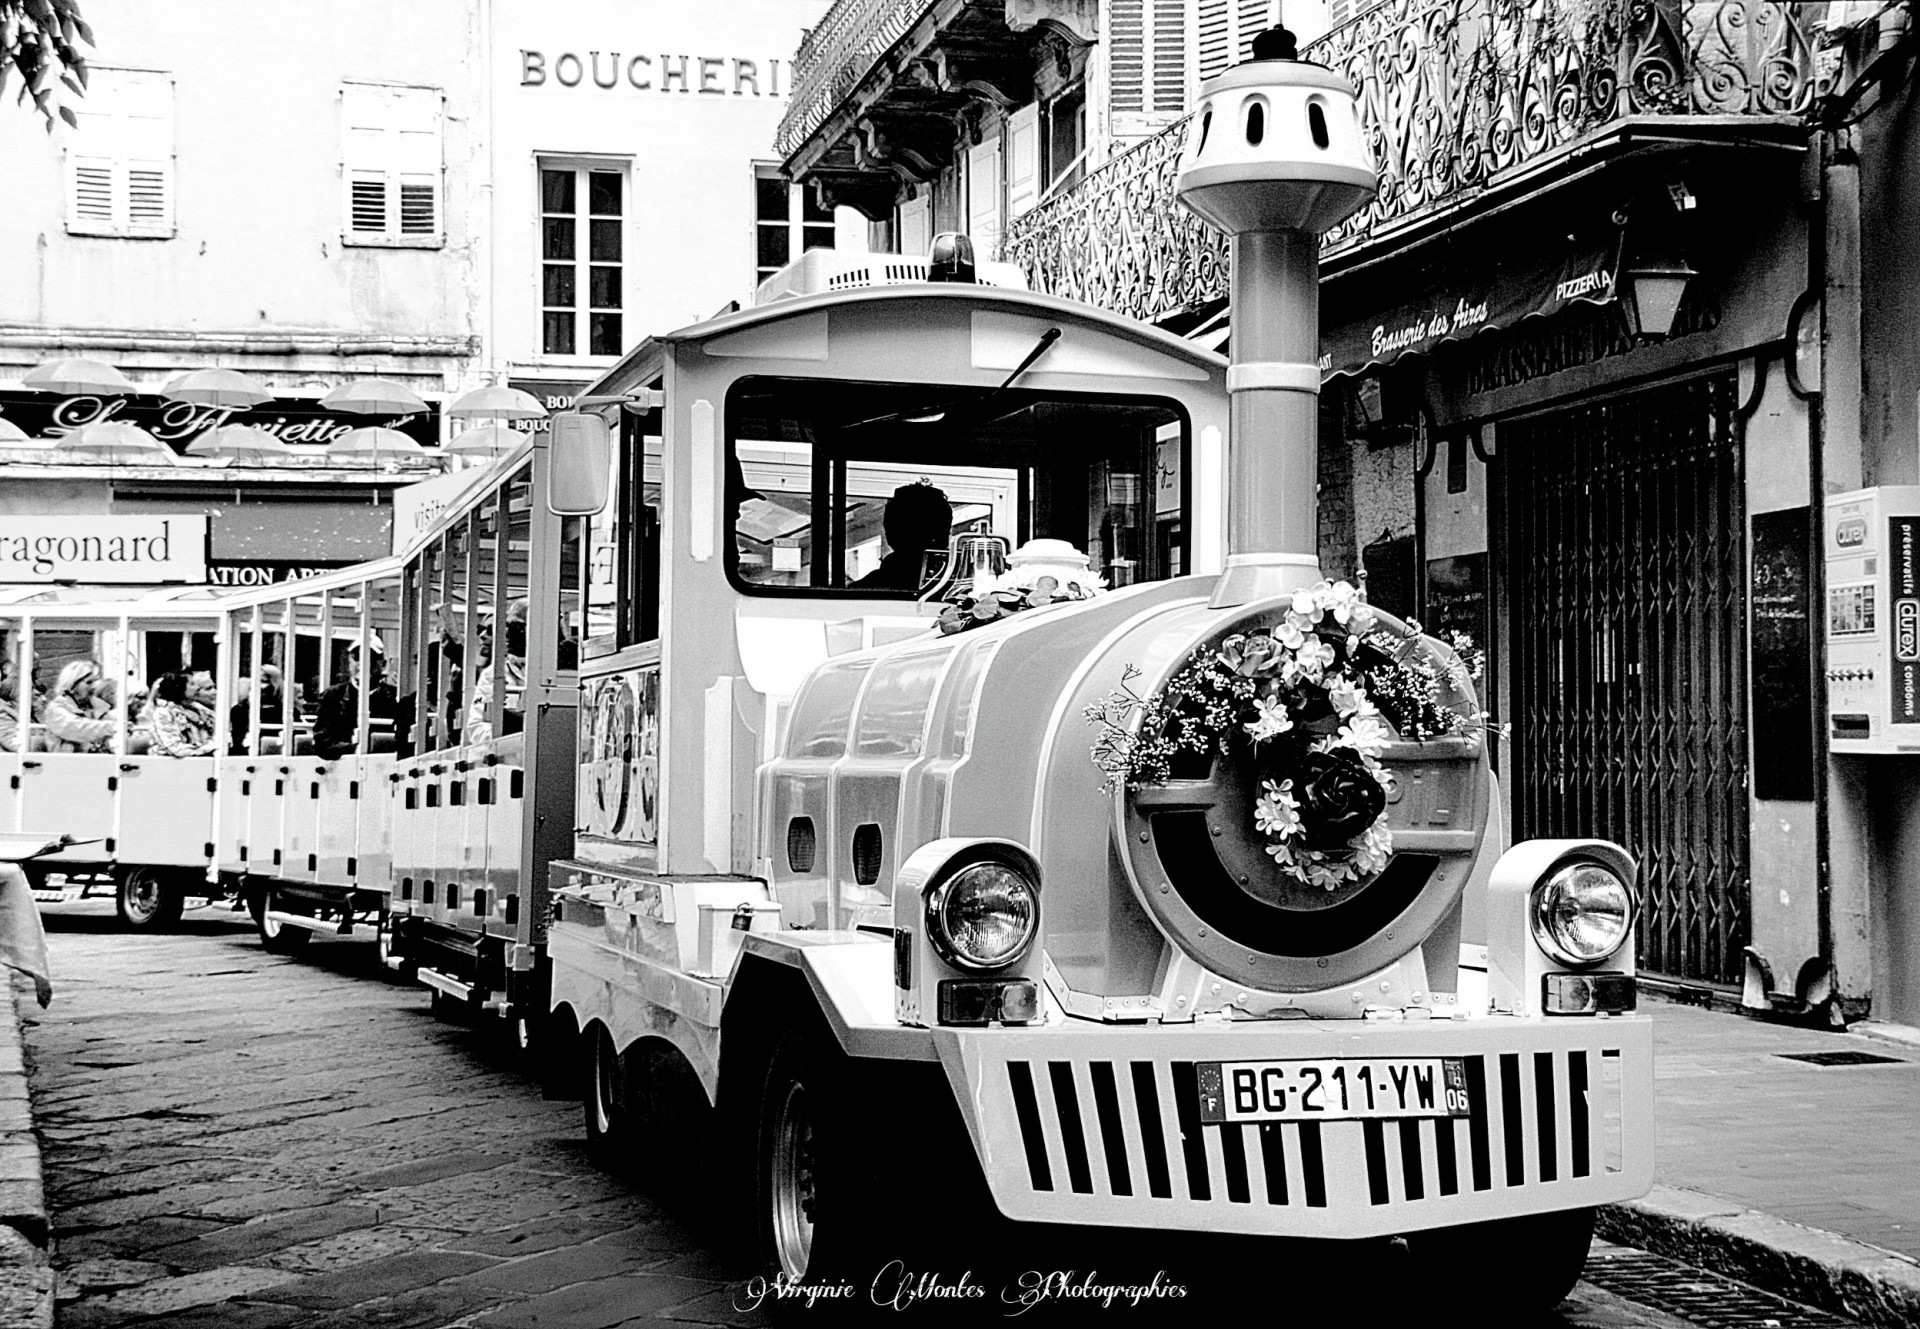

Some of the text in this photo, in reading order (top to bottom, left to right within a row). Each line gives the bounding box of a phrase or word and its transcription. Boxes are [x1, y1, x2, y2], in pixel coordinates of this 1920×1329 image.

[1555, 270, 1612, 300] PIZZERIA
[1371, 298, 1488, 356] Brasserie des Aires
[43, 396, 138, 434] L
[1900, 524, 1917, 716] préservatifs durex condoms
[1207, 1098, 1217, 1112] F
[1232, 1065, 1435, 1113] BG-211-YW
[1446, 1088, 1468, 1110] 06
